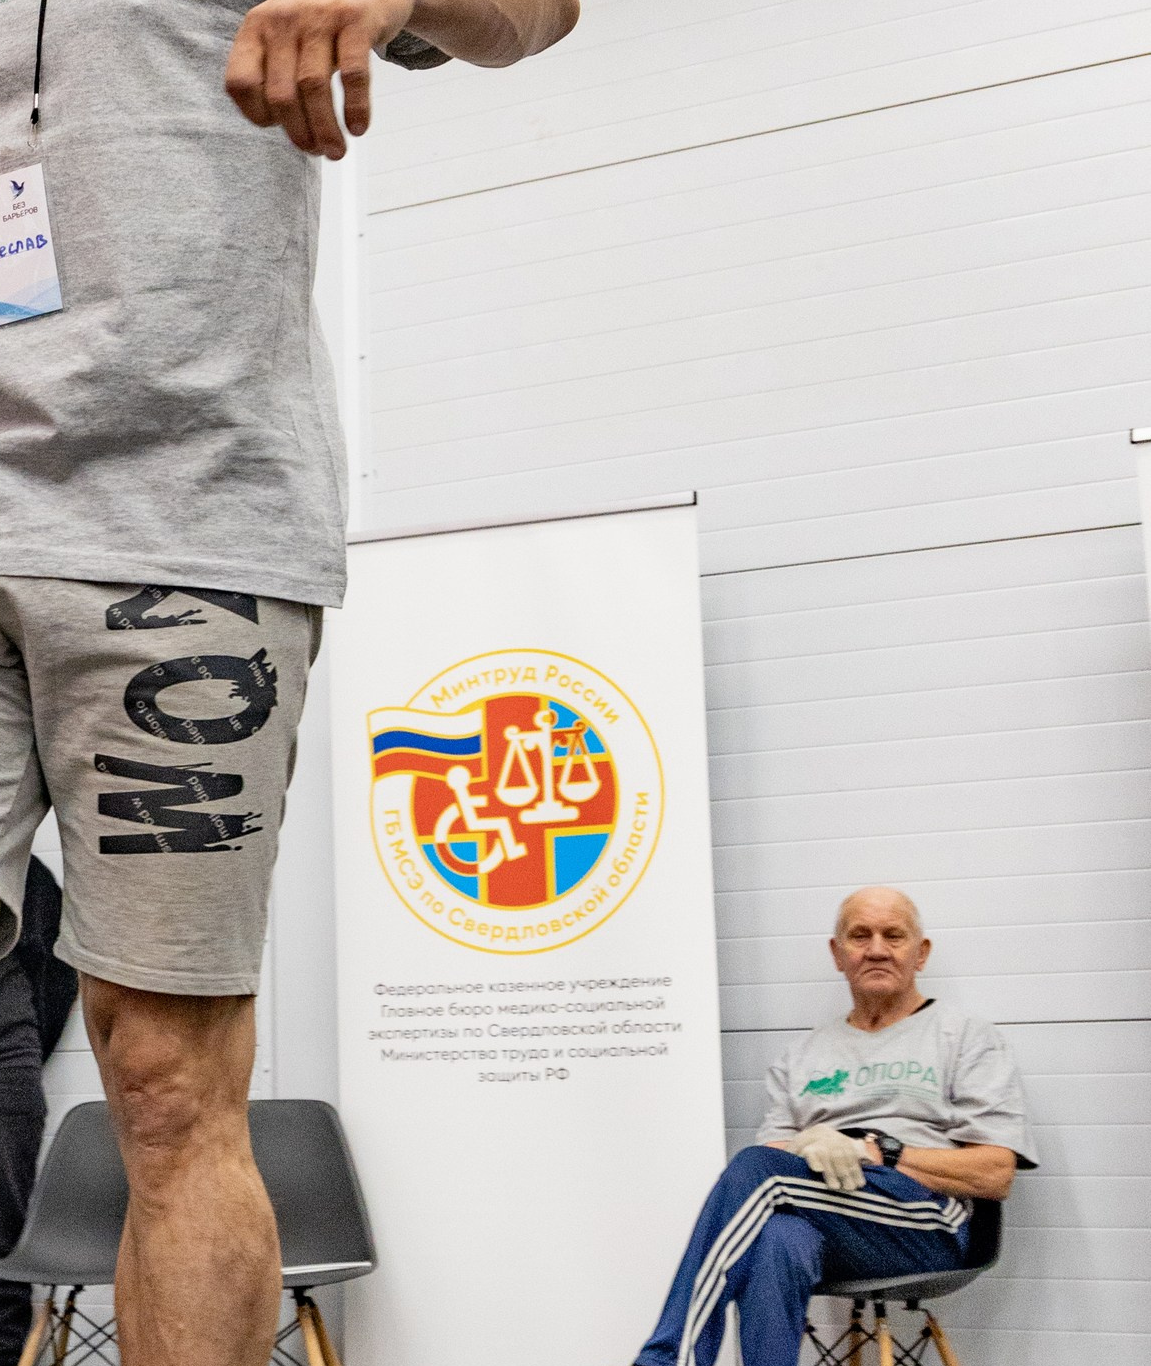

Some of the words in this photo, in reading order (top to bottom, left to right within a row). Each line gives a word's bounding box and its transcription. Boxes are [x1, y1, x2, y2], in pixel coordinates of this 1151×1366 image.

[2, 206, 38, 222] БАРЬЕРОВ
[12, 201, 26, 211] БЕЗ
[430, 665, 537, 709] Минтруд
[545, 664, 620, 725] России
[384, 808, 402, 836] ГБ
[608, 790, 650, 889] области
[389, 838, 425, 890] МСЭ
[420, 889, 445, 915] по
[447, 884, 611, 943] Свердловской
[373, 983, 484, 998] Федеральное
[489, 980, 565, 994] казенное
[568, 976, 672, 994] учреждение
[380, 1004, 445, 1018] Главное
[448, 1002, 494, 1019] бюро
[498, 996, 665, 1015] медико-социальной
[368, 1028, 459, 1043] экспертизы
[463, 1027, 484, 1038] по
[487, 1020, 608, 1040] Свердловской
[612, 1019, 682, 1035] области
[380, 1048, 498, 1064] Министерства
[502, 1048, 549, 1063] труда
[554, 1049, 563, 1059] и
[568, 1041, 668, 1059] социальной
[478, 1070, 541, 1083] защиты
[545, 1066, 570, 1081] РФ
[855, 1060, 938, 1086] ОПОРА
